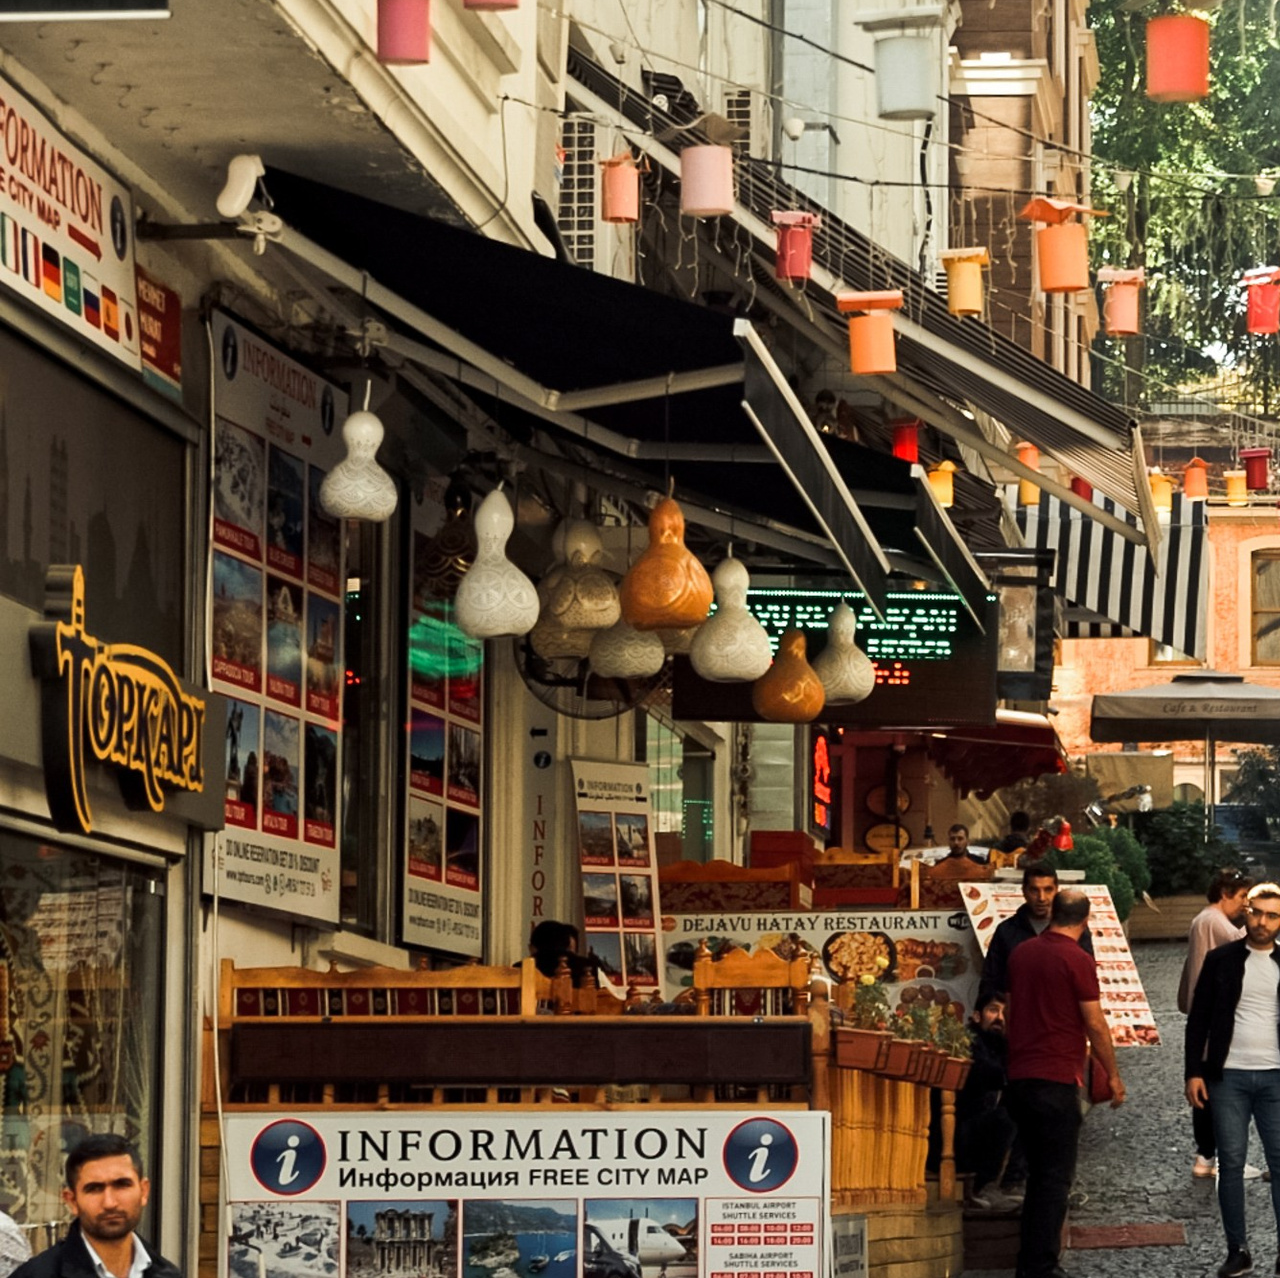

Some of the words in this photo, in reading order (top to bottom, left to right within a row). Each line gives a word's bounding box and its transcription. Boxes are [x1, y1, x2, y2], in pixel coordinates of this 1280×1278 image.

[8, 175, 34, 213] CITY
[37, 195, 61, 233] MAP
[242, 339, 317, 410] INFORMATION
[1162, 702, 1186, 715] Cafe
[1201, 702, 1258, 714] Restaurant
[587, 780, 633, 793] INFORMATION
[756, 915, 820, 931] HATAY
[824, 914, 941, 931] RESTAURANT
[338, 1127, 708, 1162] INFORMATION
[339, 1167, 518, 1192] Информация
[529, 1168, 589, 1186] FREE
[597, 1168, 649, 1186] CITY
[657, 1168, 708, 1185] MAP
[761, 1260, 798, 1268] SERVICES
